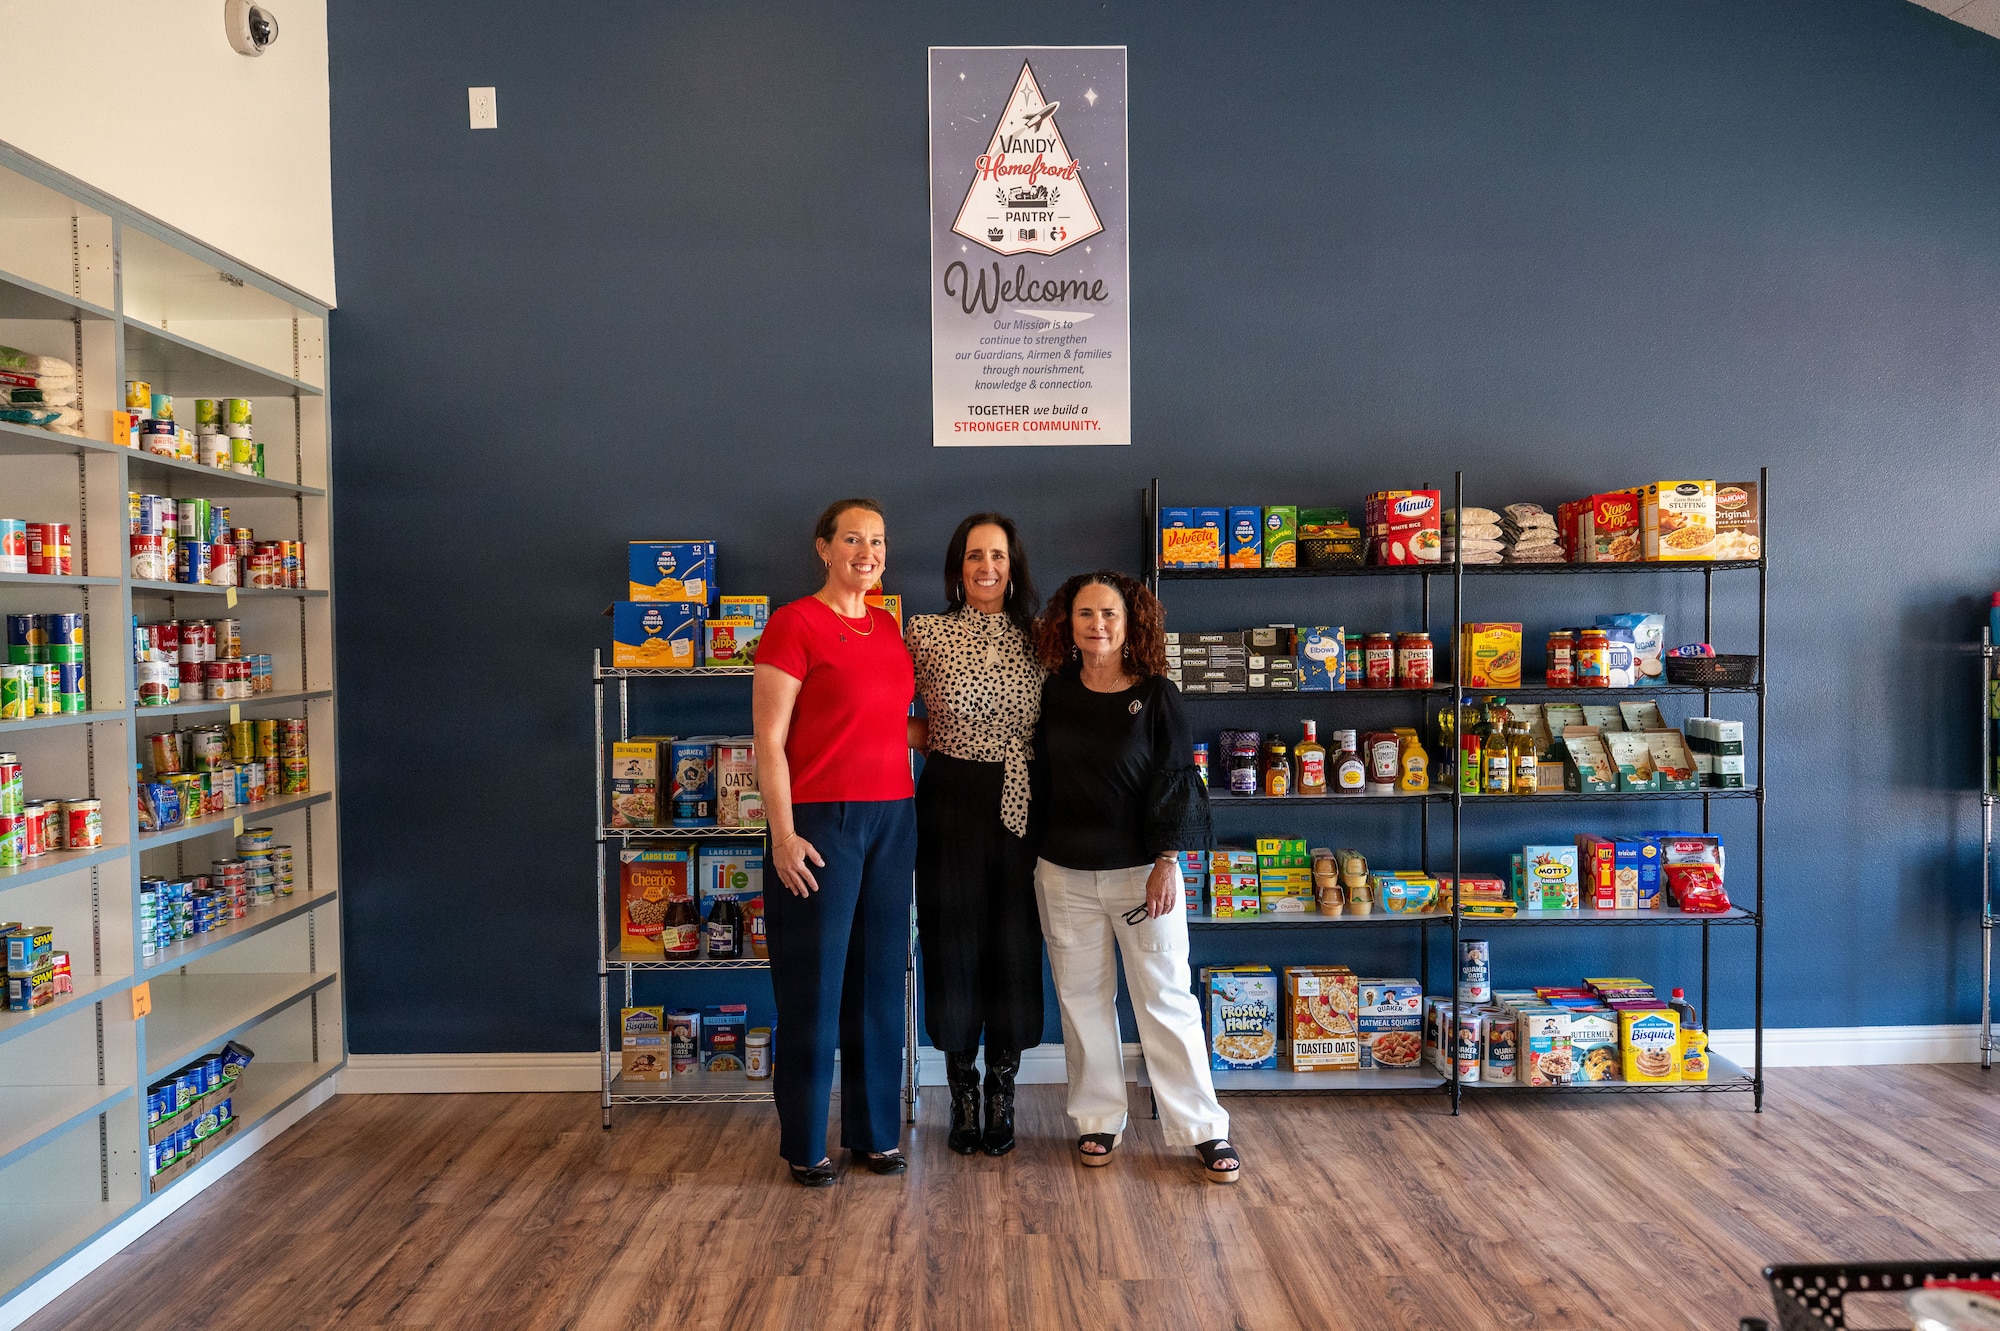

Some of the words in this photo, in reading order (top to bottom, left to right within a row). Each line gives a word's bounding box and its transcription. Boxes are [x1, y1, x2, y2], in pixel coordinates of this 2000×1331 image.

[1000, 135, 1057, 153] VANDY
[976, 153, 1081, 185] Homefront
[1005, 212, 1054, 222] PANTRY
[944, 261, 1108, 314] Welcome
[993, 320, 1011, 330] Our
[1013, 320, 1050, 329] Mission
[1052, 320, 1061, 329] is
[1063, 320, 1073, 329] to
[980, 335, 1020, 345] continue
[1023, 335, 1033, 344] to
[1035, 335, 1087, 346] strengthen
[955, 352, 972, 360] our
[974, 350, 1025, 361] Guardians,
[1027, 350, 1061, 359] Airmen
[1063, 350, 1072, 359] &
[1073, 349, 1112, 361] families
[982, 365, 1020, 377] through
[1022, 364, 1085, 375] nourishment,
[975, 380, 1026, 391] knowledge
[1029, 380, 1037, 389] &
[1039, 379, 1093, 389] connection.
[968, 405, 1030, 416] TOGETHER
[1033, 407, 1049, 415] we
[1052, 404, 1078, 414] build
[1081, 406, 1088, 414] a
[954, 421, 1019, 432] STRONGER
[1022, 420, 1101, 431] COMMUNITY.
[1717, 493, 1746, 503] IDAHOAN
[1395, 498, 1434, 514] Minute
[1597, 502, 1632, 524] Stove
[1715, 510, 1750, 520] Original
[1610, 514, 1628, 529] Top
[1168, 530, 1212, 547] Velveeta
[885, 598, 896, 606] 20
[711, 639, 737, 650] DIPPS
[1310, 646, 1335, 654] Elbows
[1634, 641, 1656, 650] UGAR
[1369, 650, 1393, 659] Prego
[1408, 650, 1431, 659] Prego
[1610, 653, 1628, 666] LOUR
[725, 772, 753, 787] OATS
[641, 853, 661, 861] LARGE
[1598, 849, 1612, 858] RITZ
[631, 872, 676, 886] Cheerios
[712, 864, 749, 889] life
[33, 933, 52, 947] SPAM
[32, 970, 52, 986] SPAM
[1377, 1005, 1404, 1013] QUAKER
[625, 1022, 659, 1031] Bisquick
[1360, 1019, 1391, 1027] OATMEAL
[1391, 1018, 1420, 1026] SQUARES
[1632, 1029, 1675, 1041] Bisquick
[1296, 1042, 1332, 1054] TOASTED
[1335, 1041, 1356, 1053] OATS
